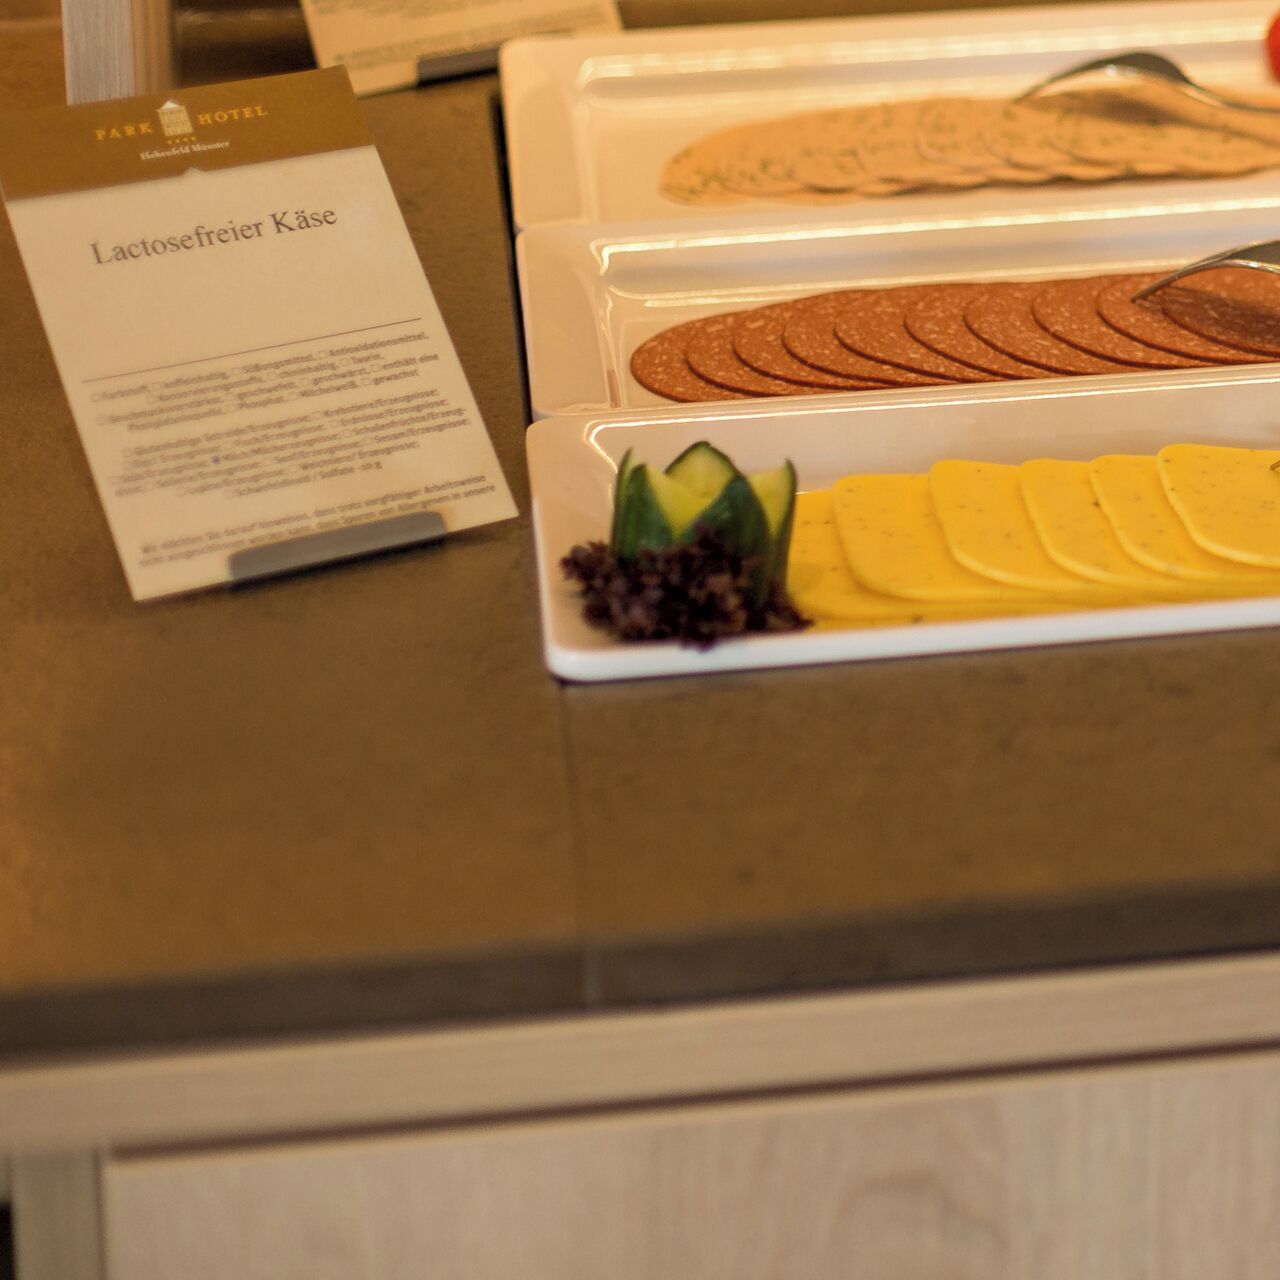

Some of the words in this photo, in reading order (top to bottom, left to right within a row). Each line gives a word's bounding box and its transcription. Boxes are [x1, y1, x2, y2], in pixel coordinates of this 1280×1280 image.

[95, 122, 152, 139] PARK
[198, 106, 267, 124] HOTEL
[140, 145, 190, 159] Hohenfeld
[191, 142, 229, 151] Münster
[90, 220, 263, 264] Lactosefreier
[269, 210, 336, 233] Käse
